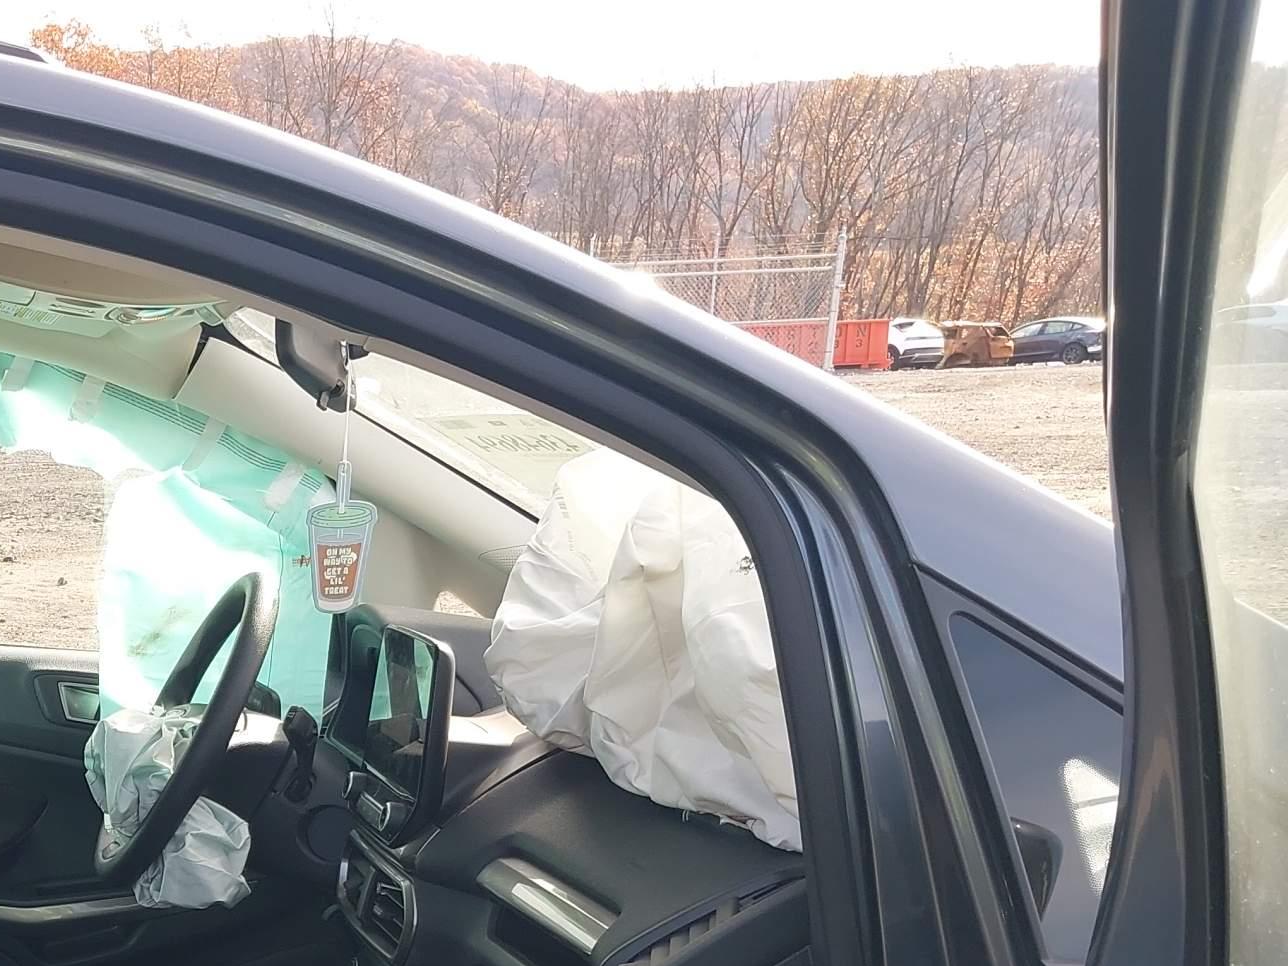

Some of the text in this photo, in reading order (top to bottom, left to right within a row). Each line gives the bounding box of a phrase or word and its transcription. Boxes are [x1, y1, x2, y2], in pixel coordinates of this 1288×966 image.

[326, 547, 352, 556] ON MY
[323, 557, 353, 567] WAY TO
[326, 566, 349, 576] GET A
[324, 586, 349, 595] TREAT
